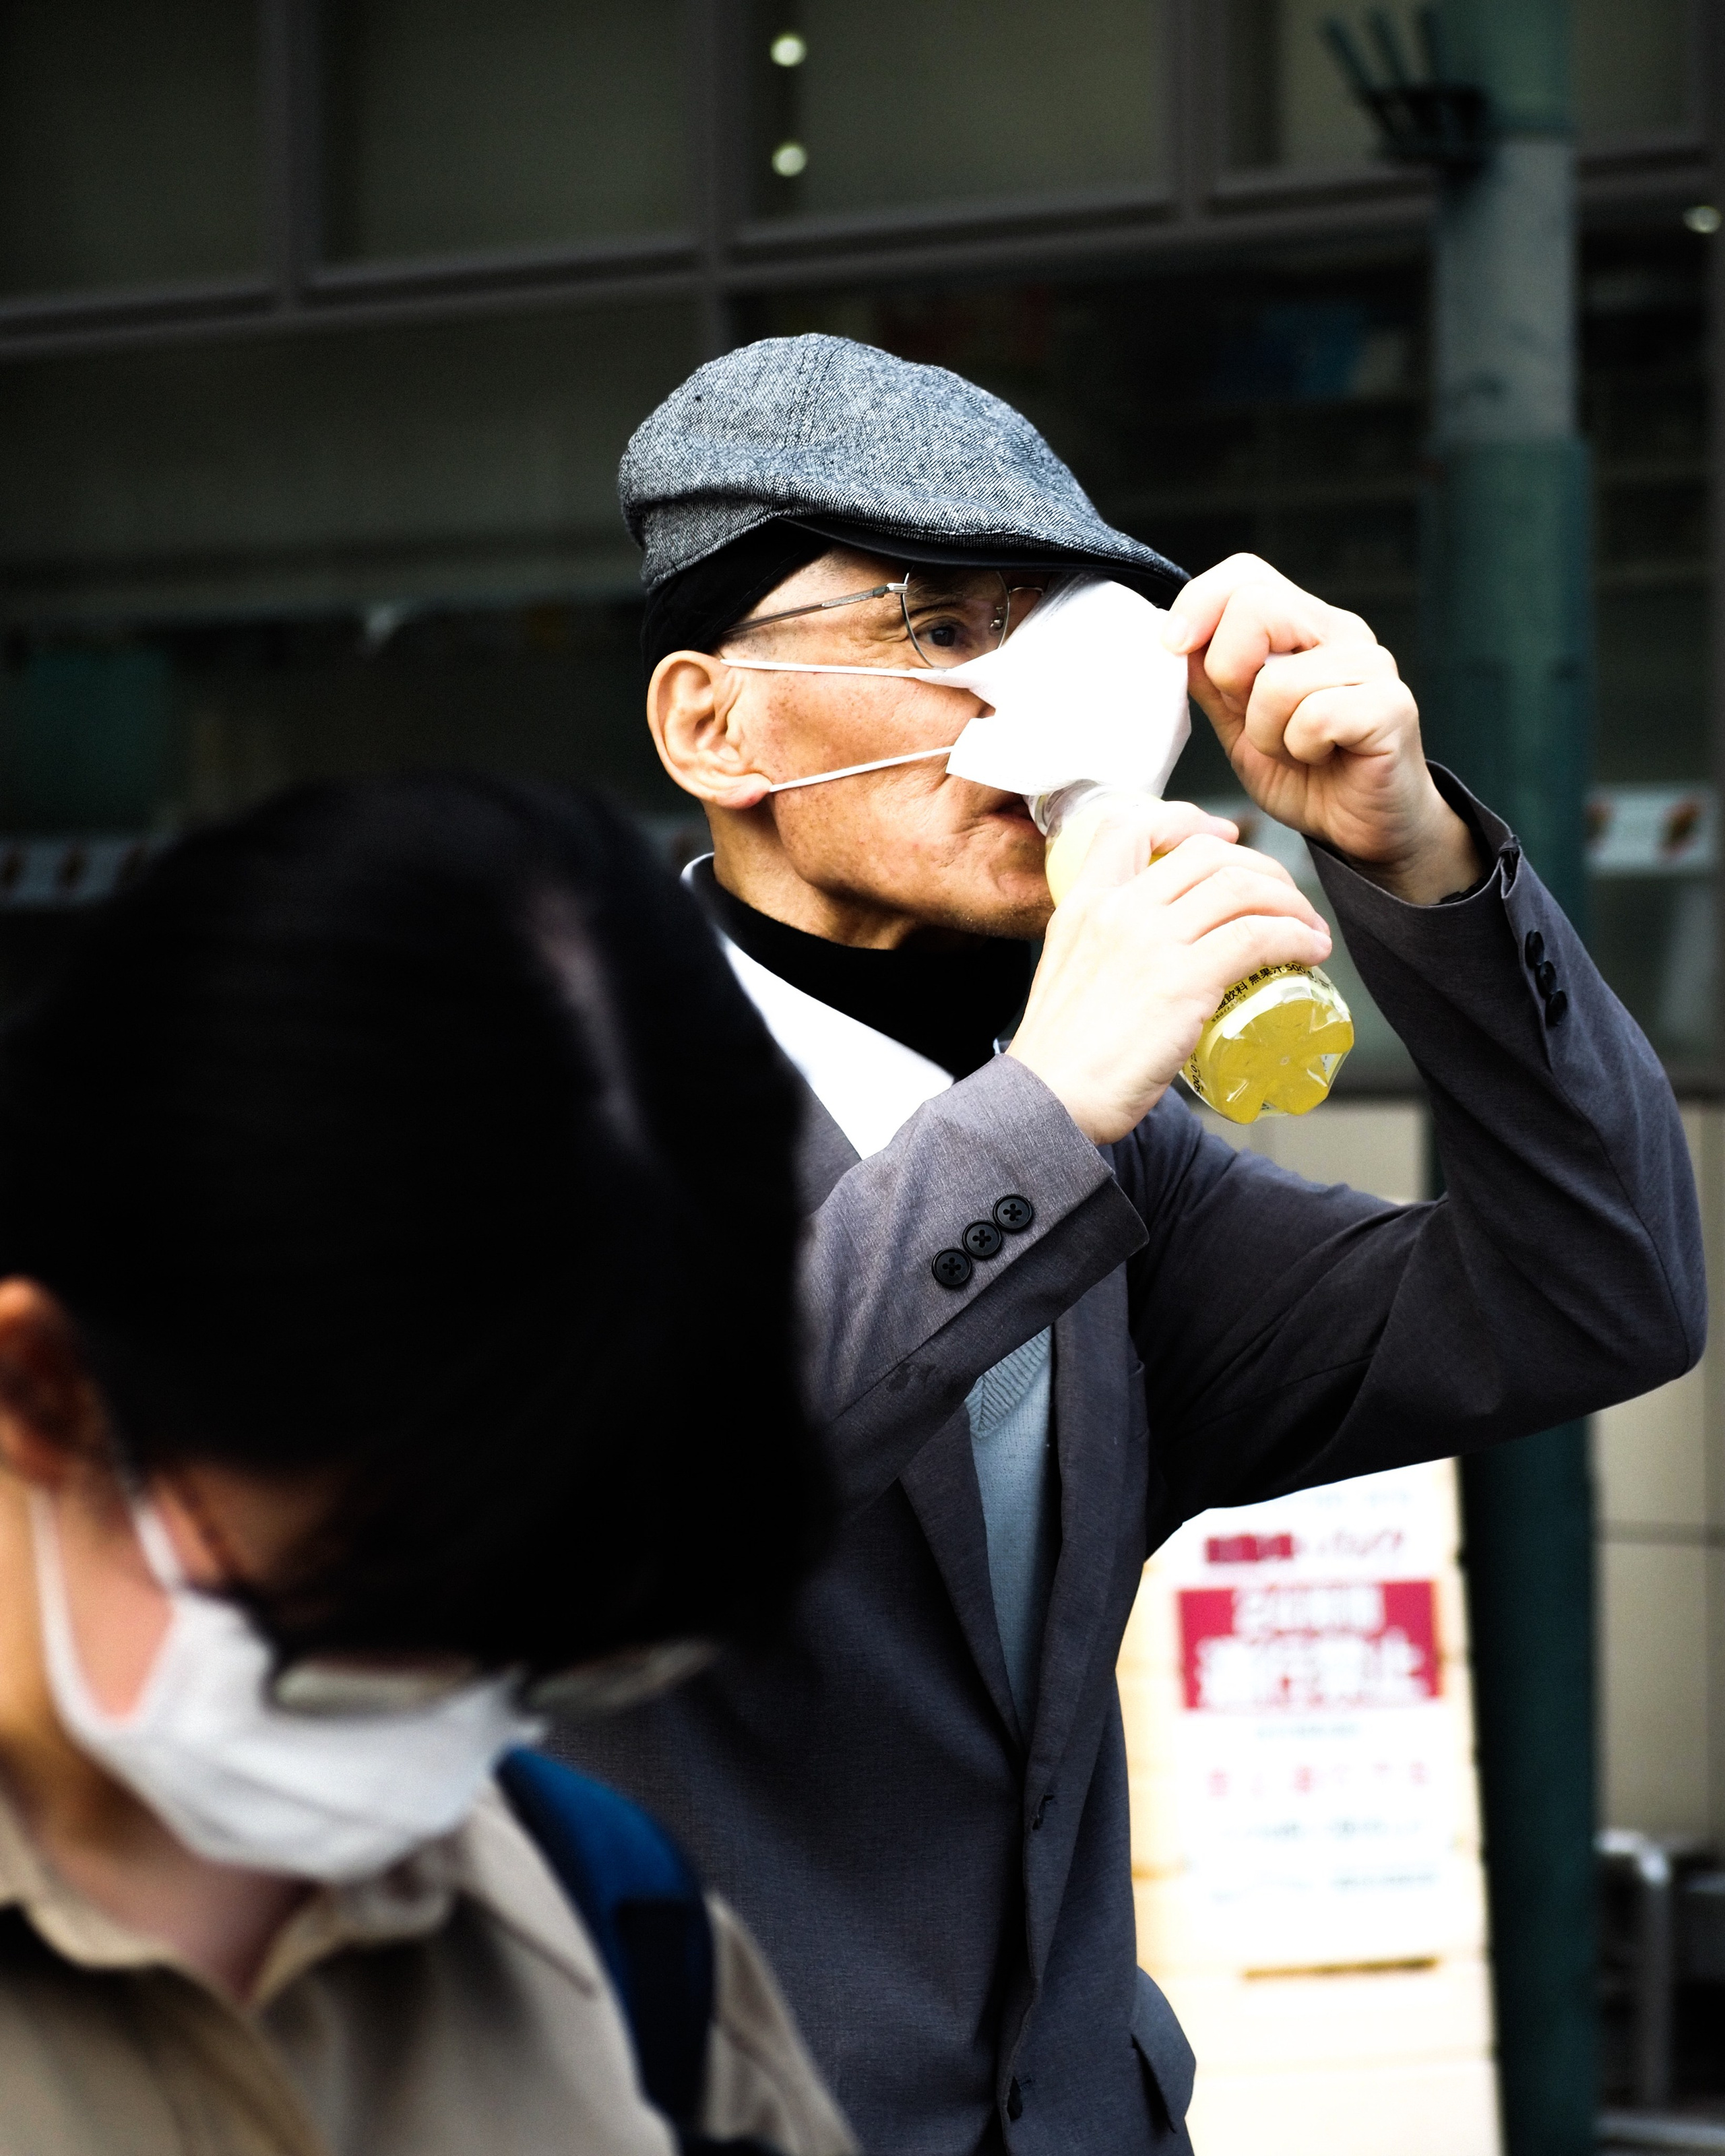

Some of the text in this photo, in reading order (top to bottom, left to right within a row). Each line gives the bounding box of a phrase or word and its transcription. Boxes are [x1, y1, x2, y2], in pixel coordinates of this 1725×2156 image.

[1216, 981, 1248, 1013] 酸飲料
[1249, 966, 1282, 986] 無果汁
